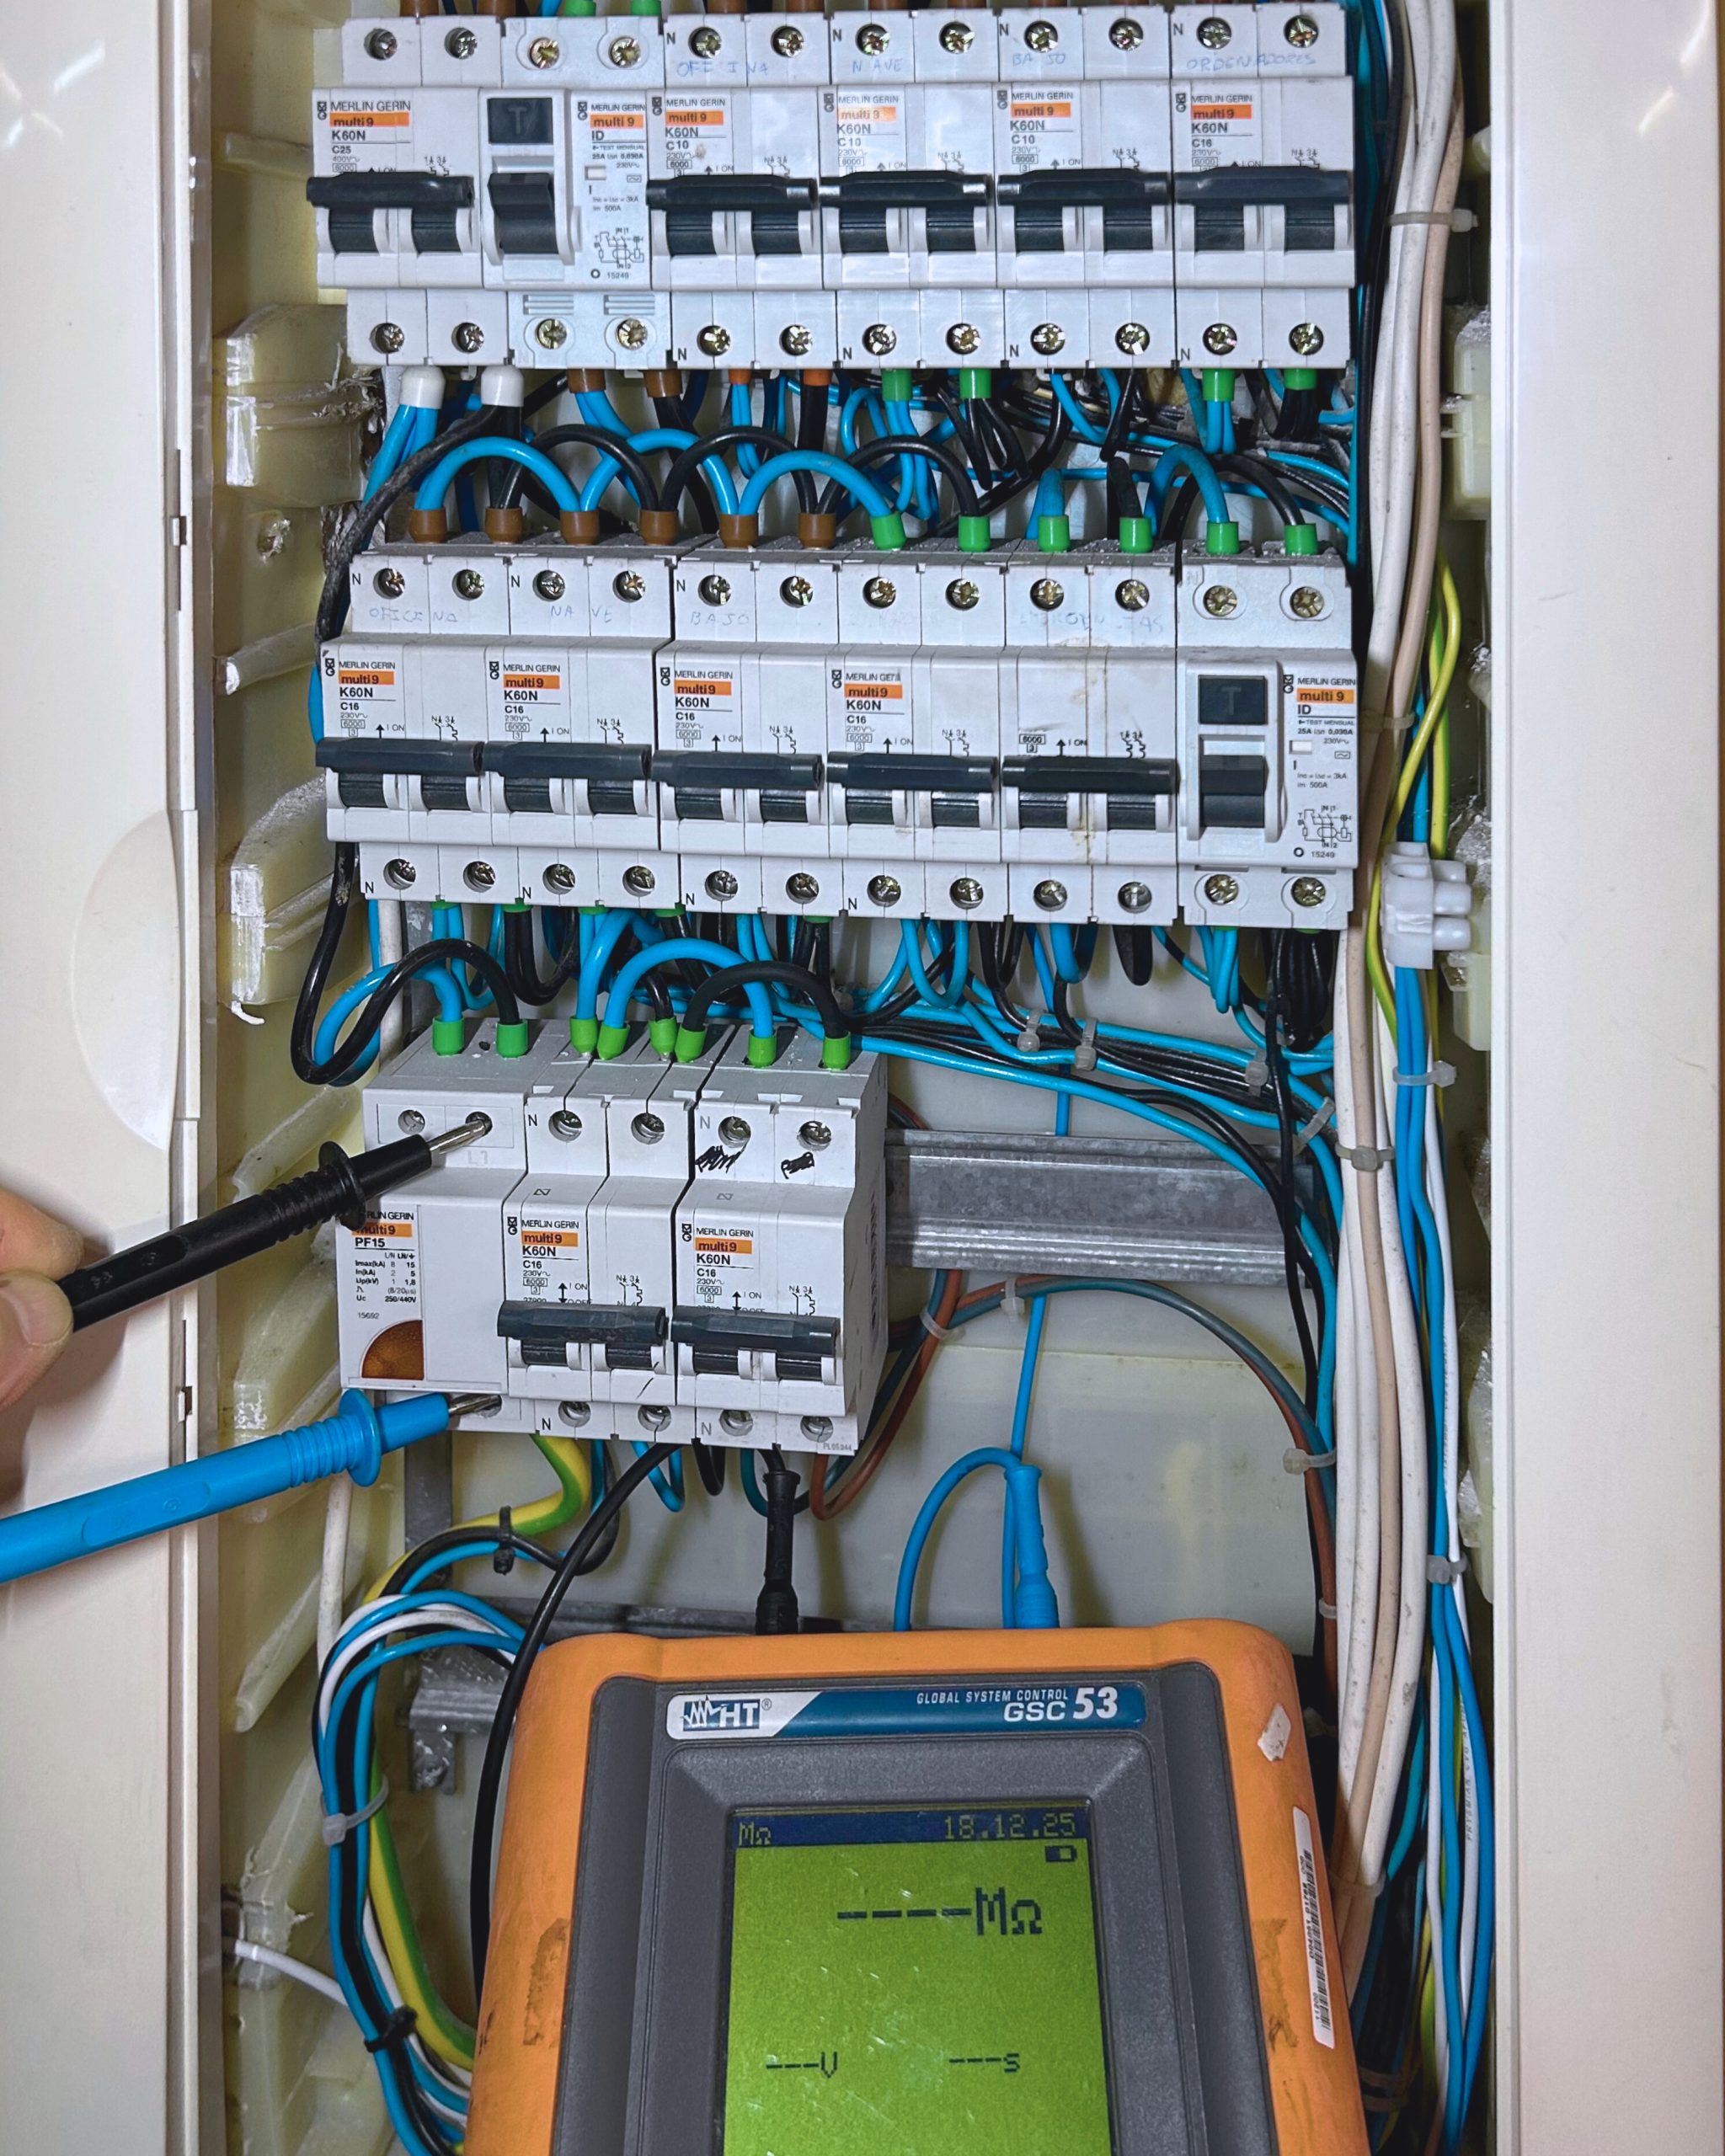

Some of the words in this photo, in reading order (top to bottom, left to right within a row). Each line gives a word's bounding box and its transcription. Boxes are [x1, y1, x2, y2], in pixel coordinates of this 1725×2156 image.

[833, 29, 842, 41] N
[1000, 24, 1008, 35] N
[1173, 24, 1183, 35] N
[666, 33, 676, 45] N
[838, 95, 870, 104] MERLIN
[873, 94, 899, 103] GERIN
[1047, 92, 1073, 100] GERIN
[330, 101, 373, 111] MERLIN
[377, 100, 411, 111] GERIN
[509, 106, 527, 136] T
[1011, 120, 1045, 131] K60N
[665, 127, 698, 138] K60N
[837, 124, 871, 135] K60N
[1192, 123, 1228, 134] K60N
[332, 131, 366, 141] K60N
[591, 131, 605, 141] ID
[1192, 139, 1212, 148] C16
[332, 146, 352, 154] C25
[677, 349, 686, 361] N
[843, 348, 852, 360] N
[1010, 344, 1018, 357] N
[1181, 348, 1190, 360] N
[352, 574, 361, 585] N
[511, 576, 521, 588] N
[677, 580, 686, 592] N
[675, 670, 706, 679] MERLIN
[708, 670, 733, 679] GERIN
[339, 687, 373, 697] K60N
[505, 690, 538, 701] K60N
[676, 696, 710, 707] K60N
[846, 700, 881, 711] K60N
[1223, 686, 1242, 715] T
[340, 702, 360, 711] C16
[505, 705, 524, 714] C16
[1297, 705, 1311, 715] ID
[676, 712, 695, 721] C16
[846, 715, 867, 724] C16
[366, 882, 374, 894] N
[523, 887, 531, 899] N
[686, 893, 695, 905] N
[847, 897, 857, 910] N
[528, 1113, 538, 1127] N
[700, 1116, 711, 1129] N
[387, 1211, 414, 1220] GERIN
[521, 1219, 553, 1228] MERLIN
[554, 1220, 579, 1229] GERIN
[696, 1228, 728, 1236] MERLIN
[729, 1229, 754, 1237] GERIN
[355, 1237, 386, 1248] PF15
[522, 1246, 557, 1257] K60N
[523, 1260, 542, 1269] C16
[697, 1253, 731, 1265] K60N
[697, 1267, 716, 1278] C16
[542, 1417, 552, 1431] N
[701, 1422, 712, 1435] N
[916, 1692, 960, 1705] GLOBAL
[965, 1690, 1011, 1703] SYSTEM
[1017, 1688, 1069, 1701] CONTROL
[1004, 1701, 1066, 1722] GSC
[1073, 1686, 1119, 1720] 53
[943, 1812, 1076, 1840] 18.12.25
